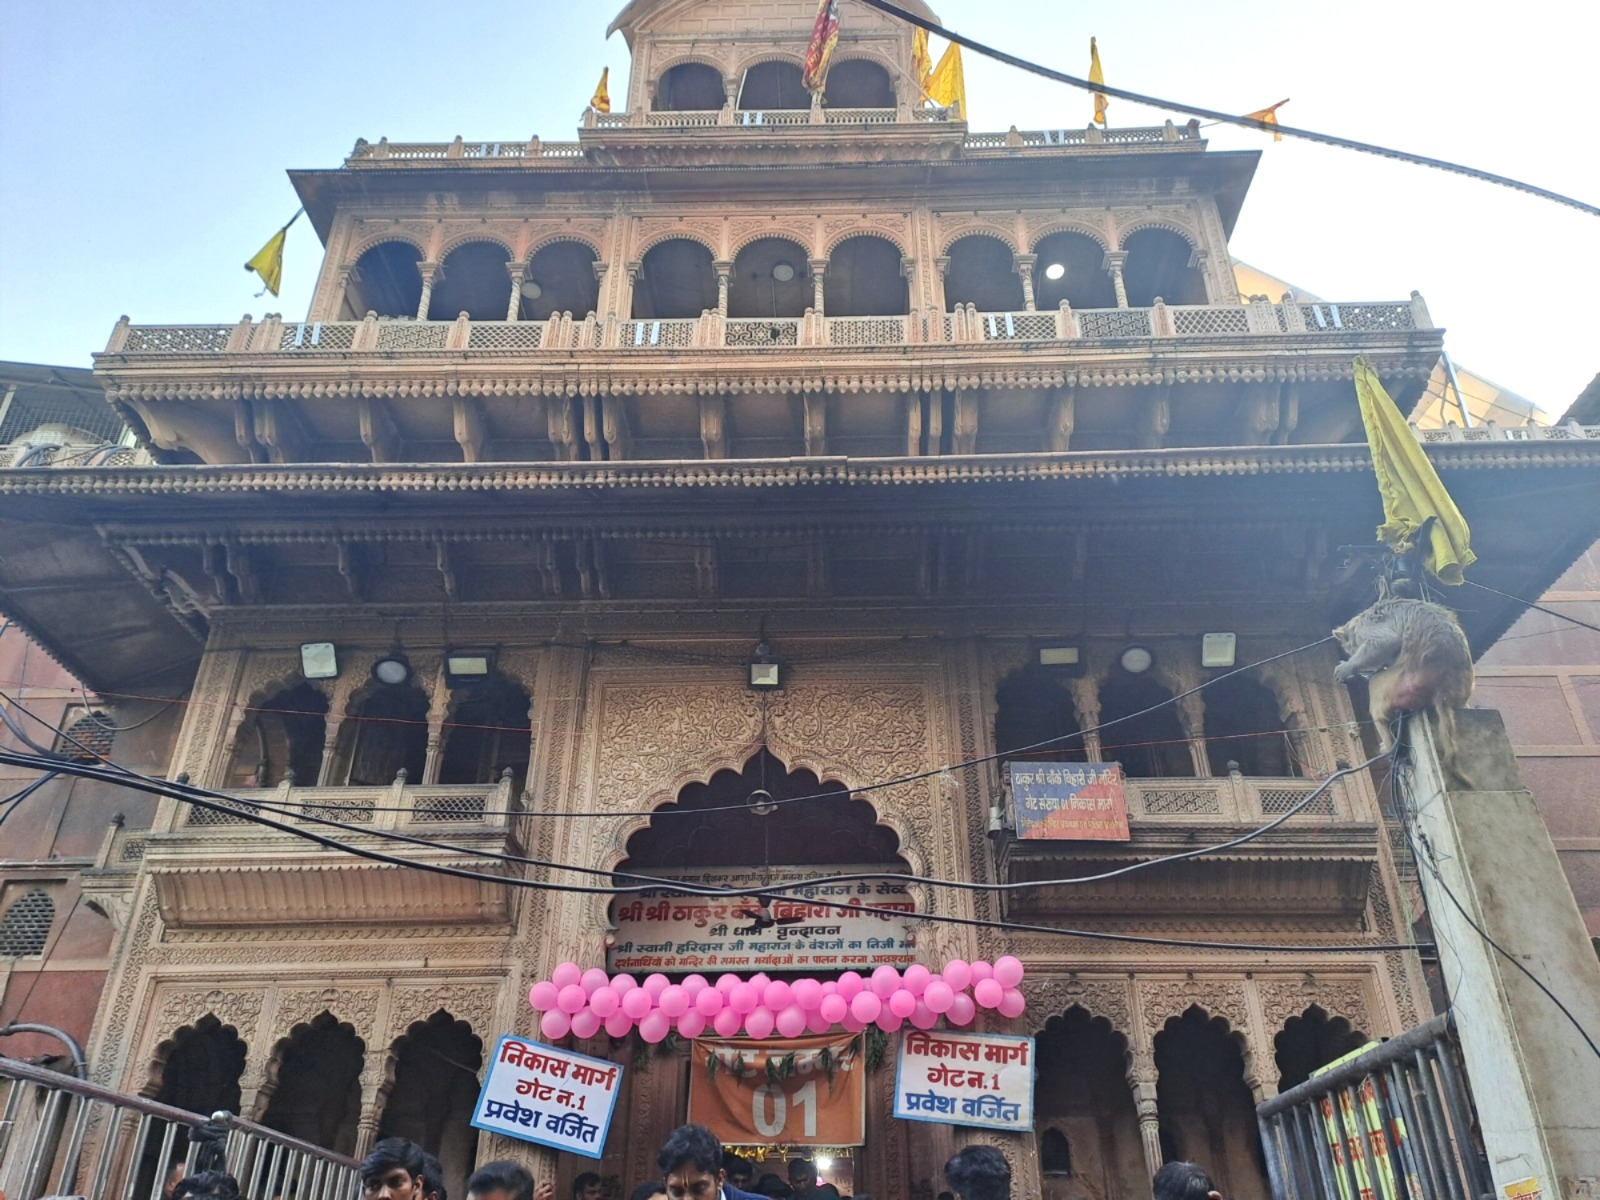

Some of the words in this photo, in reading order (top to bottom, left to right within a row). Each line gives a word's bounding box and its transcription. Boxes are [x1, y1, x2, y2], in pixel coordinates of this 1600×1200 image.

[1036, 768, 1045, 785] श्री
[1069, 793, 1096, 811] निकास
[792, 884, 852, 899] महाराज
[857, 881, 871, 895] के
[618, 901, 644, 921] श्री
[645, 900, 671, 921] श्री
[672, 905, 730, 928] ठाकुर
[835, 897, 861, 919] जी
[709, 923, 728, 937] श्री
[777, 925, 842, 941] वृन्दावन
[616, 940, 633, 953] श्री
[636, 940, 673, 953] स्वामी
[676, 939, 725, 955] हरिदास
[728, 938, 745, 951] जी
[749, 941, 792, 953] महाराज
[795, 939, 806, 951] के
[808, 938, 845, 950] वंशजों
[848, 940, 862, 950] का
[866, 937, 894, 950] निजी
[664, 955, 677, 967] को
[707, 954, 718, 966] की
[797, 955, 809, 965] का
[813, 954, 838, 965] पालन
[841, 954, 867, 965] करना
[906, 1032, 981, 1062] निकास
[984, 1042, 1029, 1066] मार्ग
[500, 1041, 570, 1079] निकास
[572, 1064, 617, 1091] मार्ग
[927, 1063, 965, 1087] गेट
[515, 1077, 556, 1101] गेट
[752, 1080, 817, 1137] 01
[905, 1089, 957, 1114] प्रवेश
[962, 1094, 1021, 1121] वर्जित
[484, 1099, 542, 1128] प्रवेश
[545, 1112, 599, 1143] वर्जित
